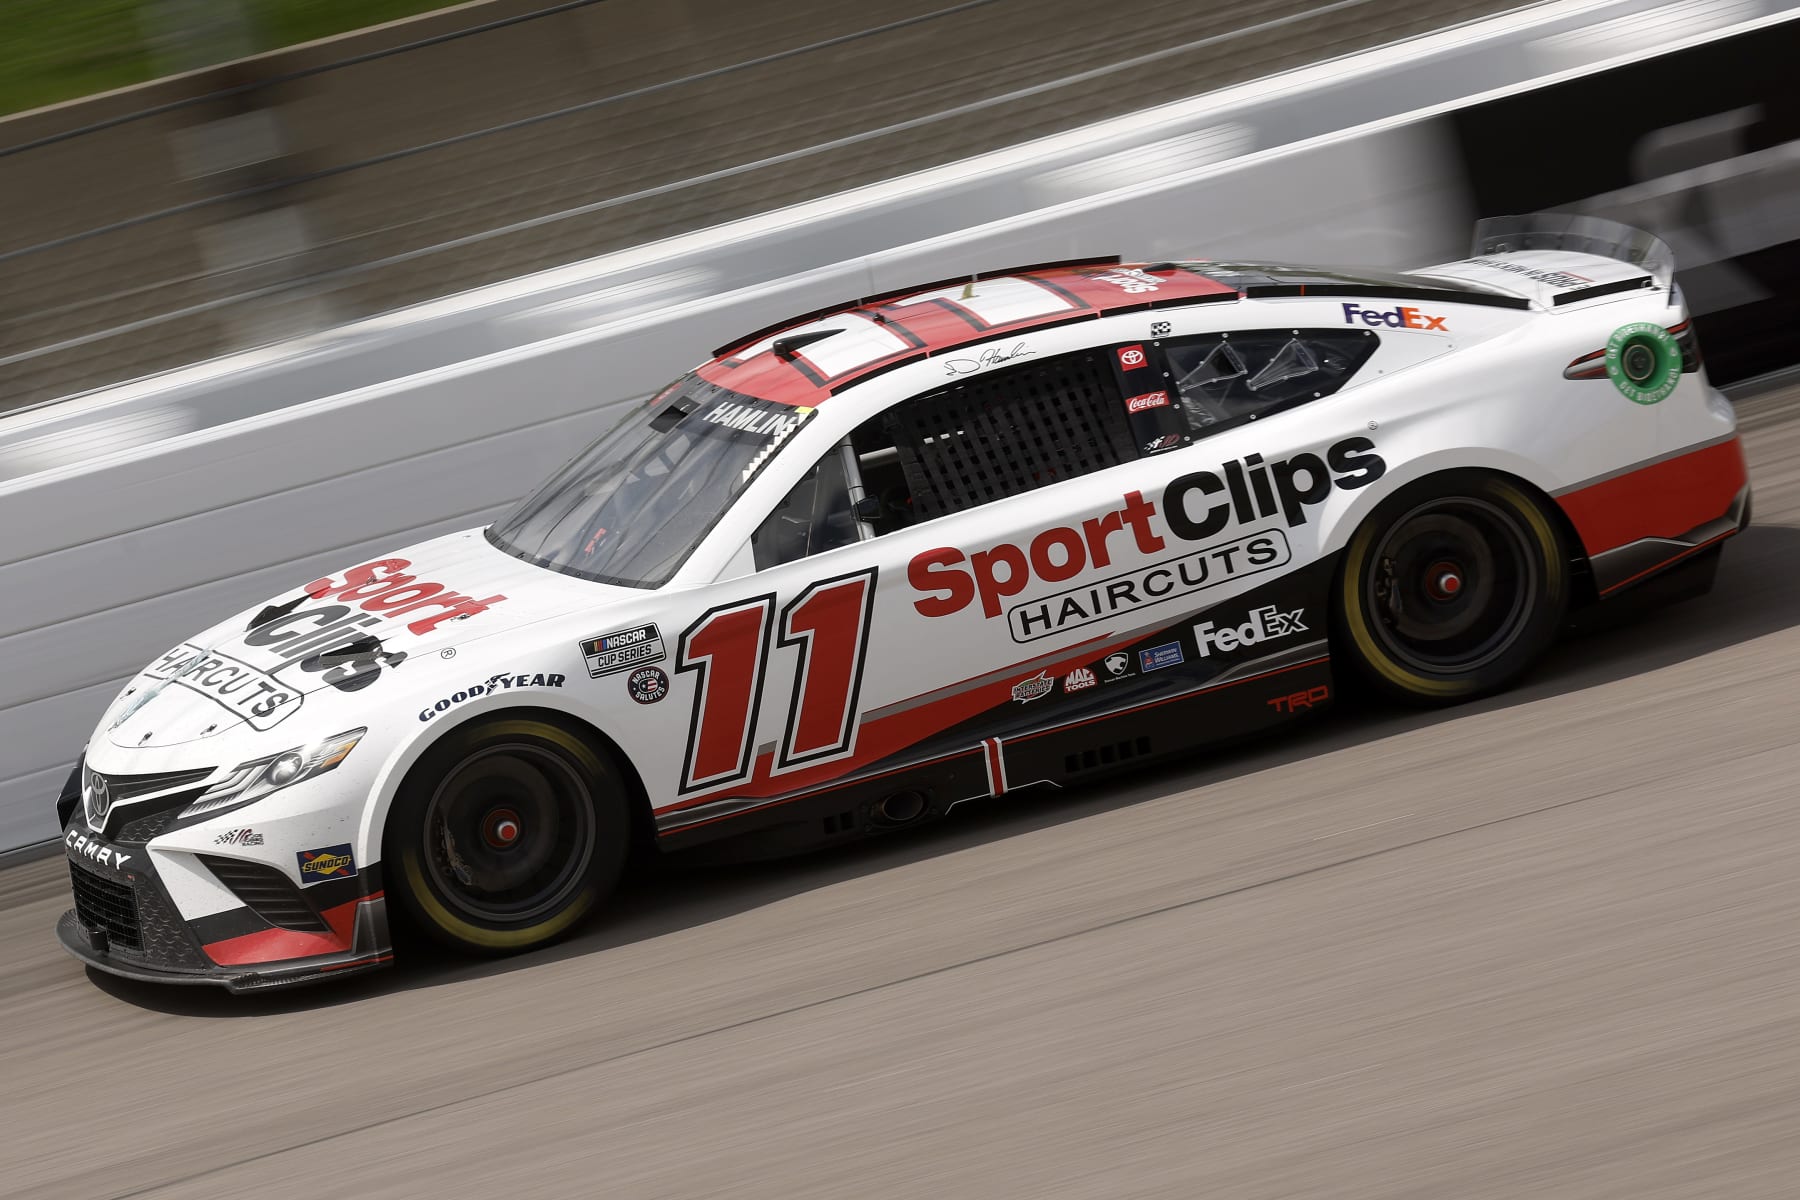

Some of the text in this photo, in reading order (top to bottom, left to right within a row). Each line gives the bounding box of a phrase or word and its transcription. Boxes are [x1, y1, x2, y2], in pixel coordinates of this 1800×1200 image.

[1342, 302, 1449, 332] FedEx
[703, 402, 797, 436] HAMLIN
[907, 436, 1387, 619] Sport Clips
[304, 558, 508, 636] Sport
[1017, 536, 1279, 636] HAIRCUTS
[605, 629, 647, 648] NASCAR
[1192, 604, 1309, 658] FedEx
[244, 604, 408, 692] Clips
[597, 644, 653, 667] CUP SERIES
[632, 670, 661, 685] NASCAR
[674, 565, 879, 796] 11
[1065, 668, 1095, 687] MAC
[1065, 680, 1096, 692] TOOLS
[635, 686, 665, 701] SALUTES
[1267, 685, 1329, 712] TRD
[302, 855, 350, 873] SUNOCO
